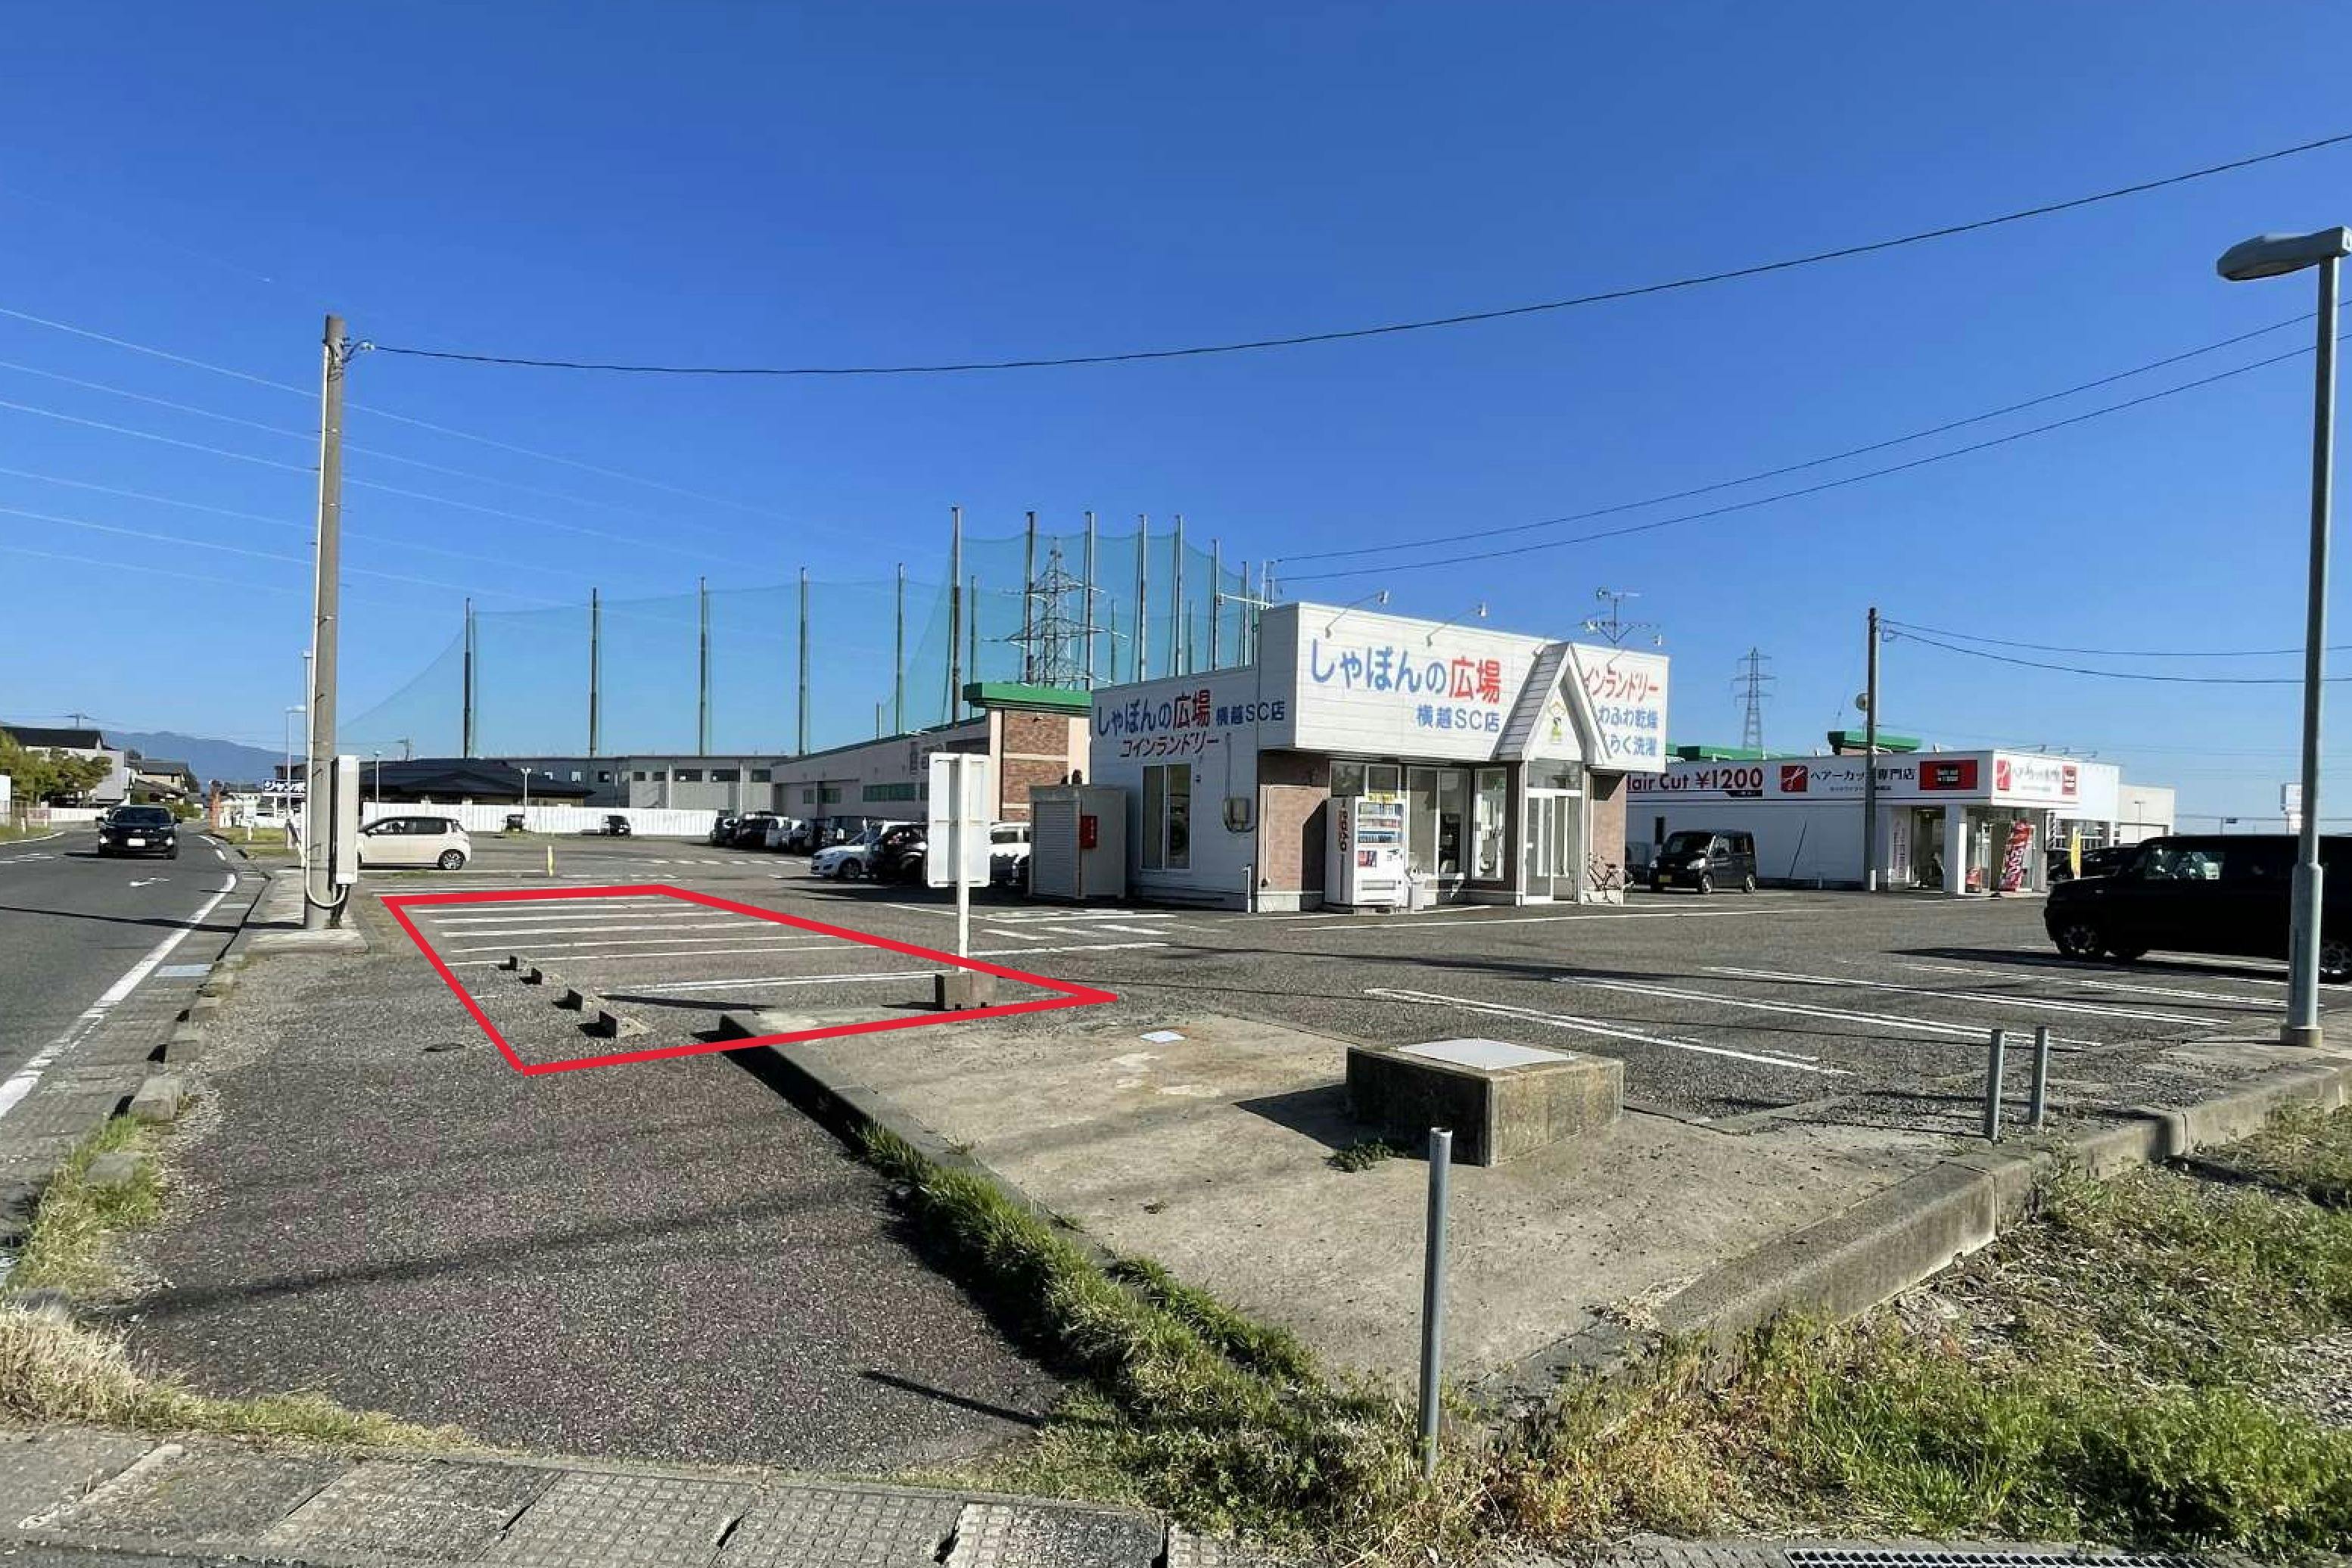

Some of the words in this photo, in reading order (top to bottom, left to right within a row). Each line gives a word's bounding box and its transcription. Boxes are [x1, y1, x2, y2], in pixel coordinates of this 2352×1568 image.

[1311, 638, 1501, 702] しゃぼんの広場
[1098, 689, 1211, 737] しゃぼんの広場
[1119, 730, 1220, 758] コインランドリー
[1660, 773, 1689, 790] Cut
[1695, 767, 1763, 789] ¥1200
[1810, 767, 1915, 782] ヘアーカッ専門店
